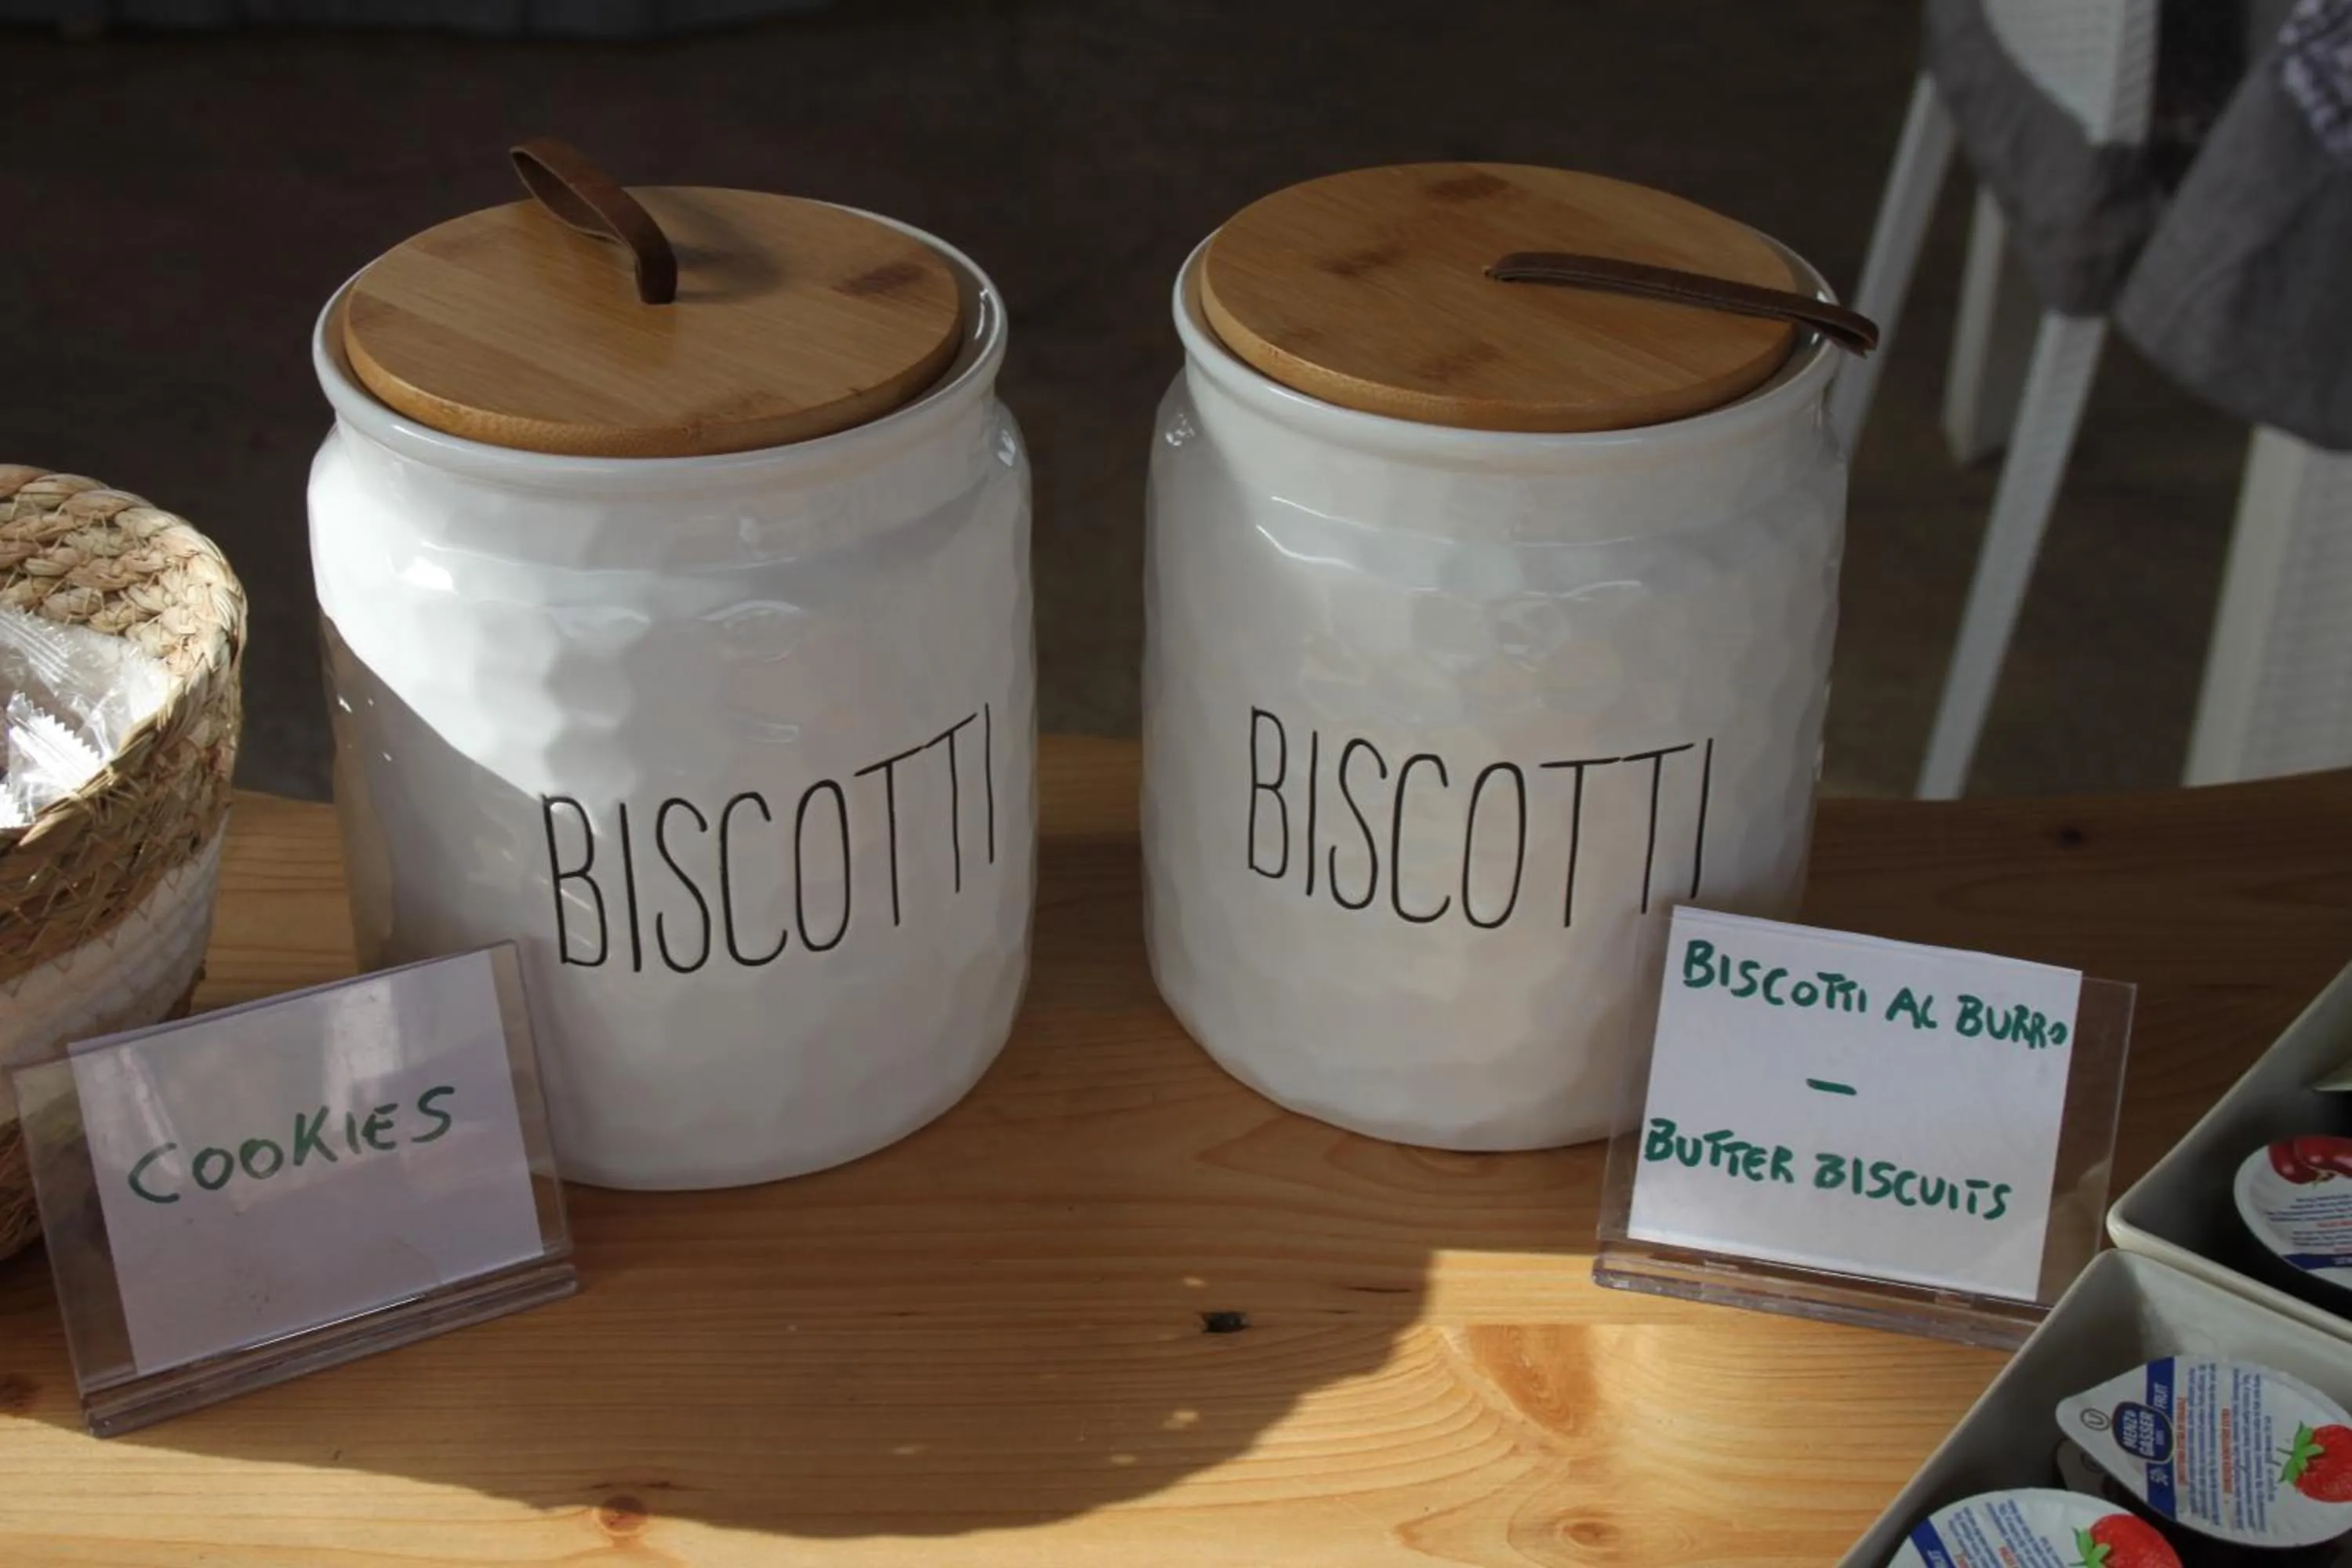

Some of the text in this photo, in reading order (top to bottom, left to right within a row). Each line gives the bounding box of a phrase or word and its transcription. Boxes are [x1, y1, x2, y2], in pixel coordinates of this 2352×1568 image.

[542, 703, 994, 972] BISCOTTI
[1248, 706, 1714, 929] BISCOTTI
[1682, 940, 2068, 1049] BISCOTTI AL BURRO
[128, 1085, 455, 1203] COOKIES
[1643, 1118, 2013, 1220] BUTTER BISCUITS
